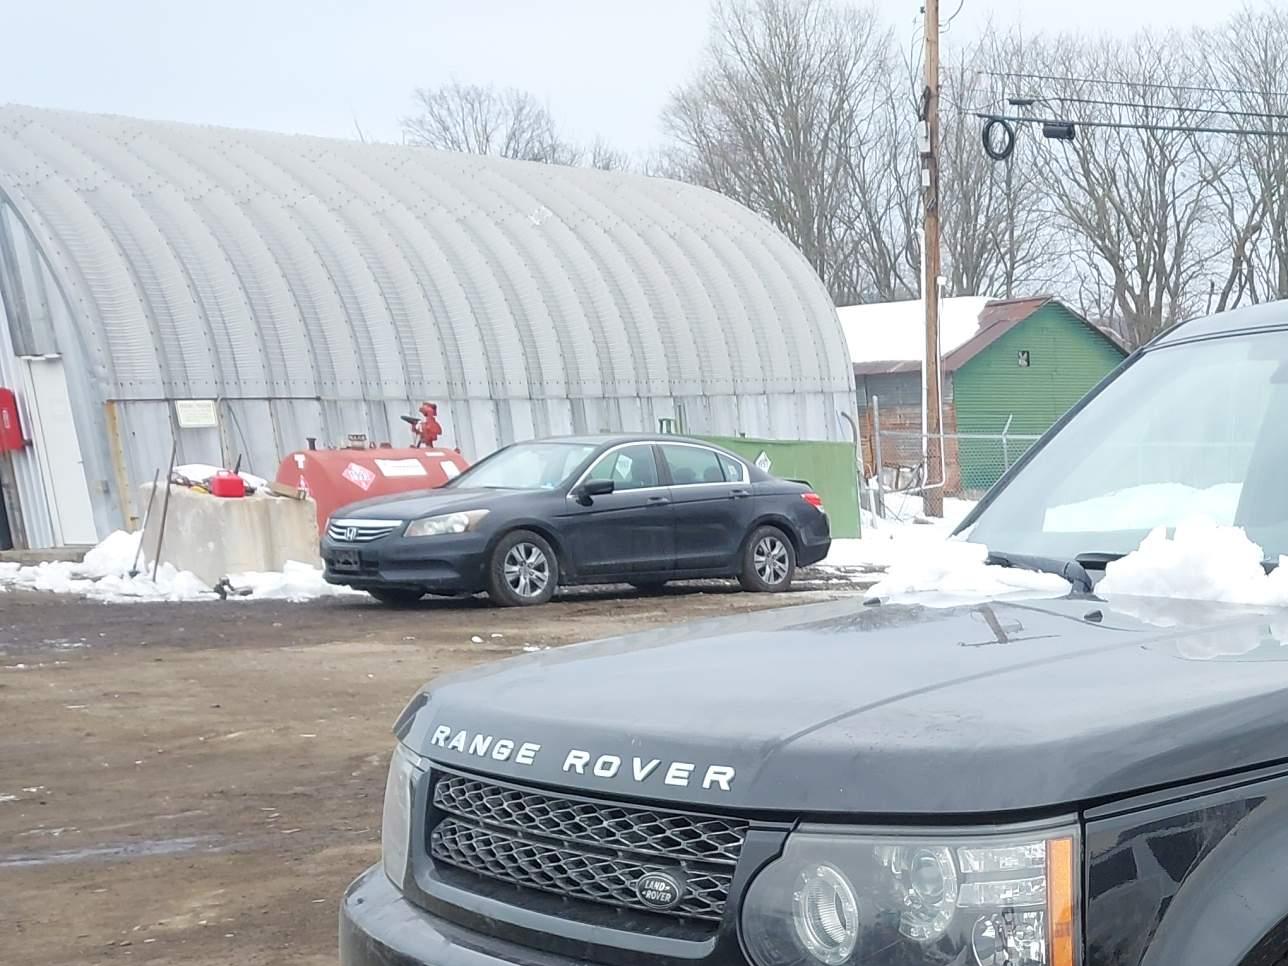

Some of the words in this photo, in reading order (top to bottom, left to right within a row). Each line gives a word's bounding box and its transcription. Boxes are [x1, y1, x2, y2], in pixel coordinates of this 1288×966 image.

[431, 725, 541, 766] RANGE
[562, 749, 736, 792] ROVER
[644, 880, 666, 891] LAND
[645, 890, 672, 902] ROVER
